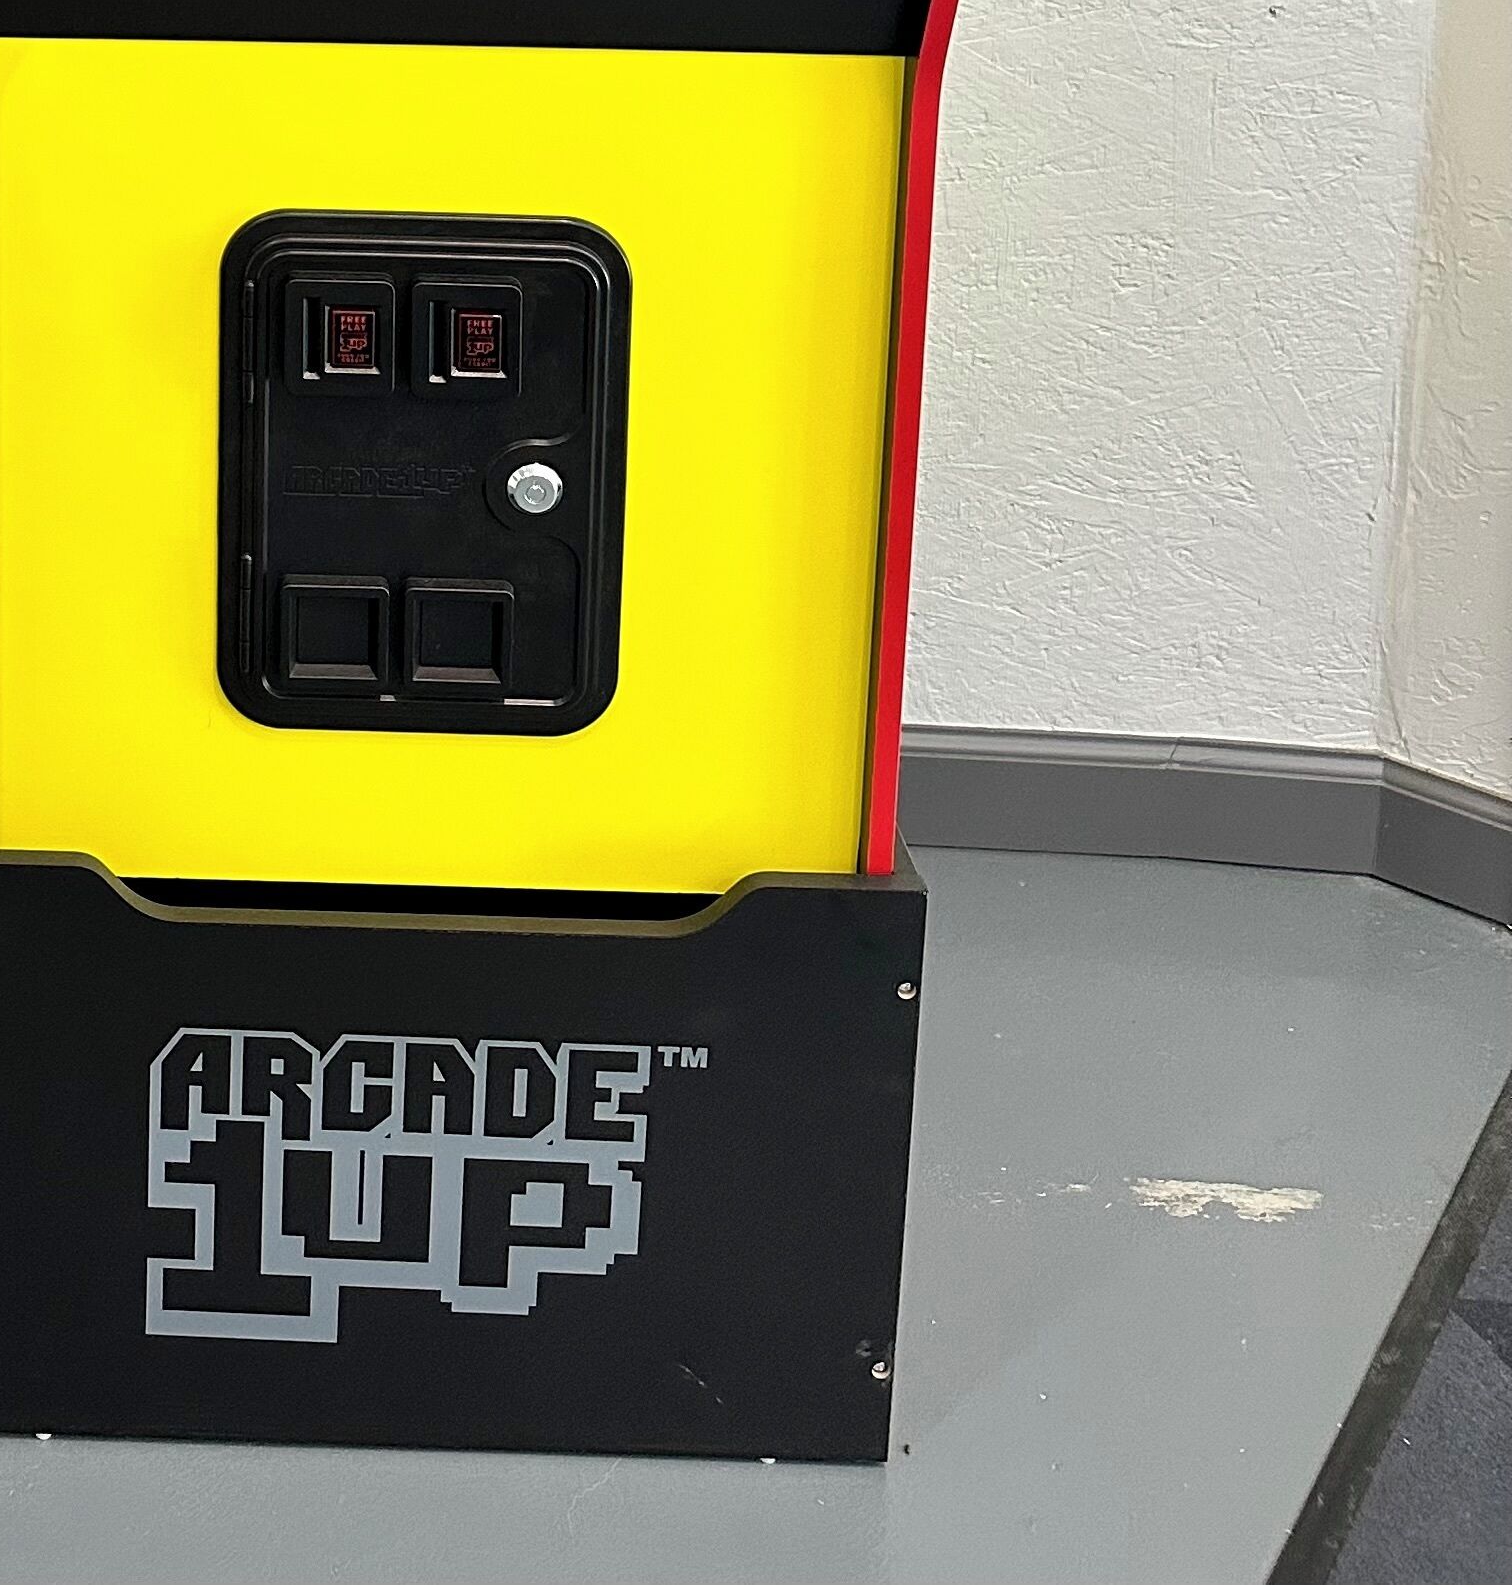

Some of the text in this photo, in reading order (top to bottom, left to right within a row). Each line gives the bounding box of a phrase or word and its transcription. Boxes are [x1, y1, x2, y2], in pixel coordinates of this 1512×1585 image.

[340, 315, 367, 324] FREE
[466, 319, 494, 327] FREE
[340, 323, 367, 332] PLAY
[467, 327, 494, 335] PLAY
[152, 1028, 651, 1145] ARCADE
